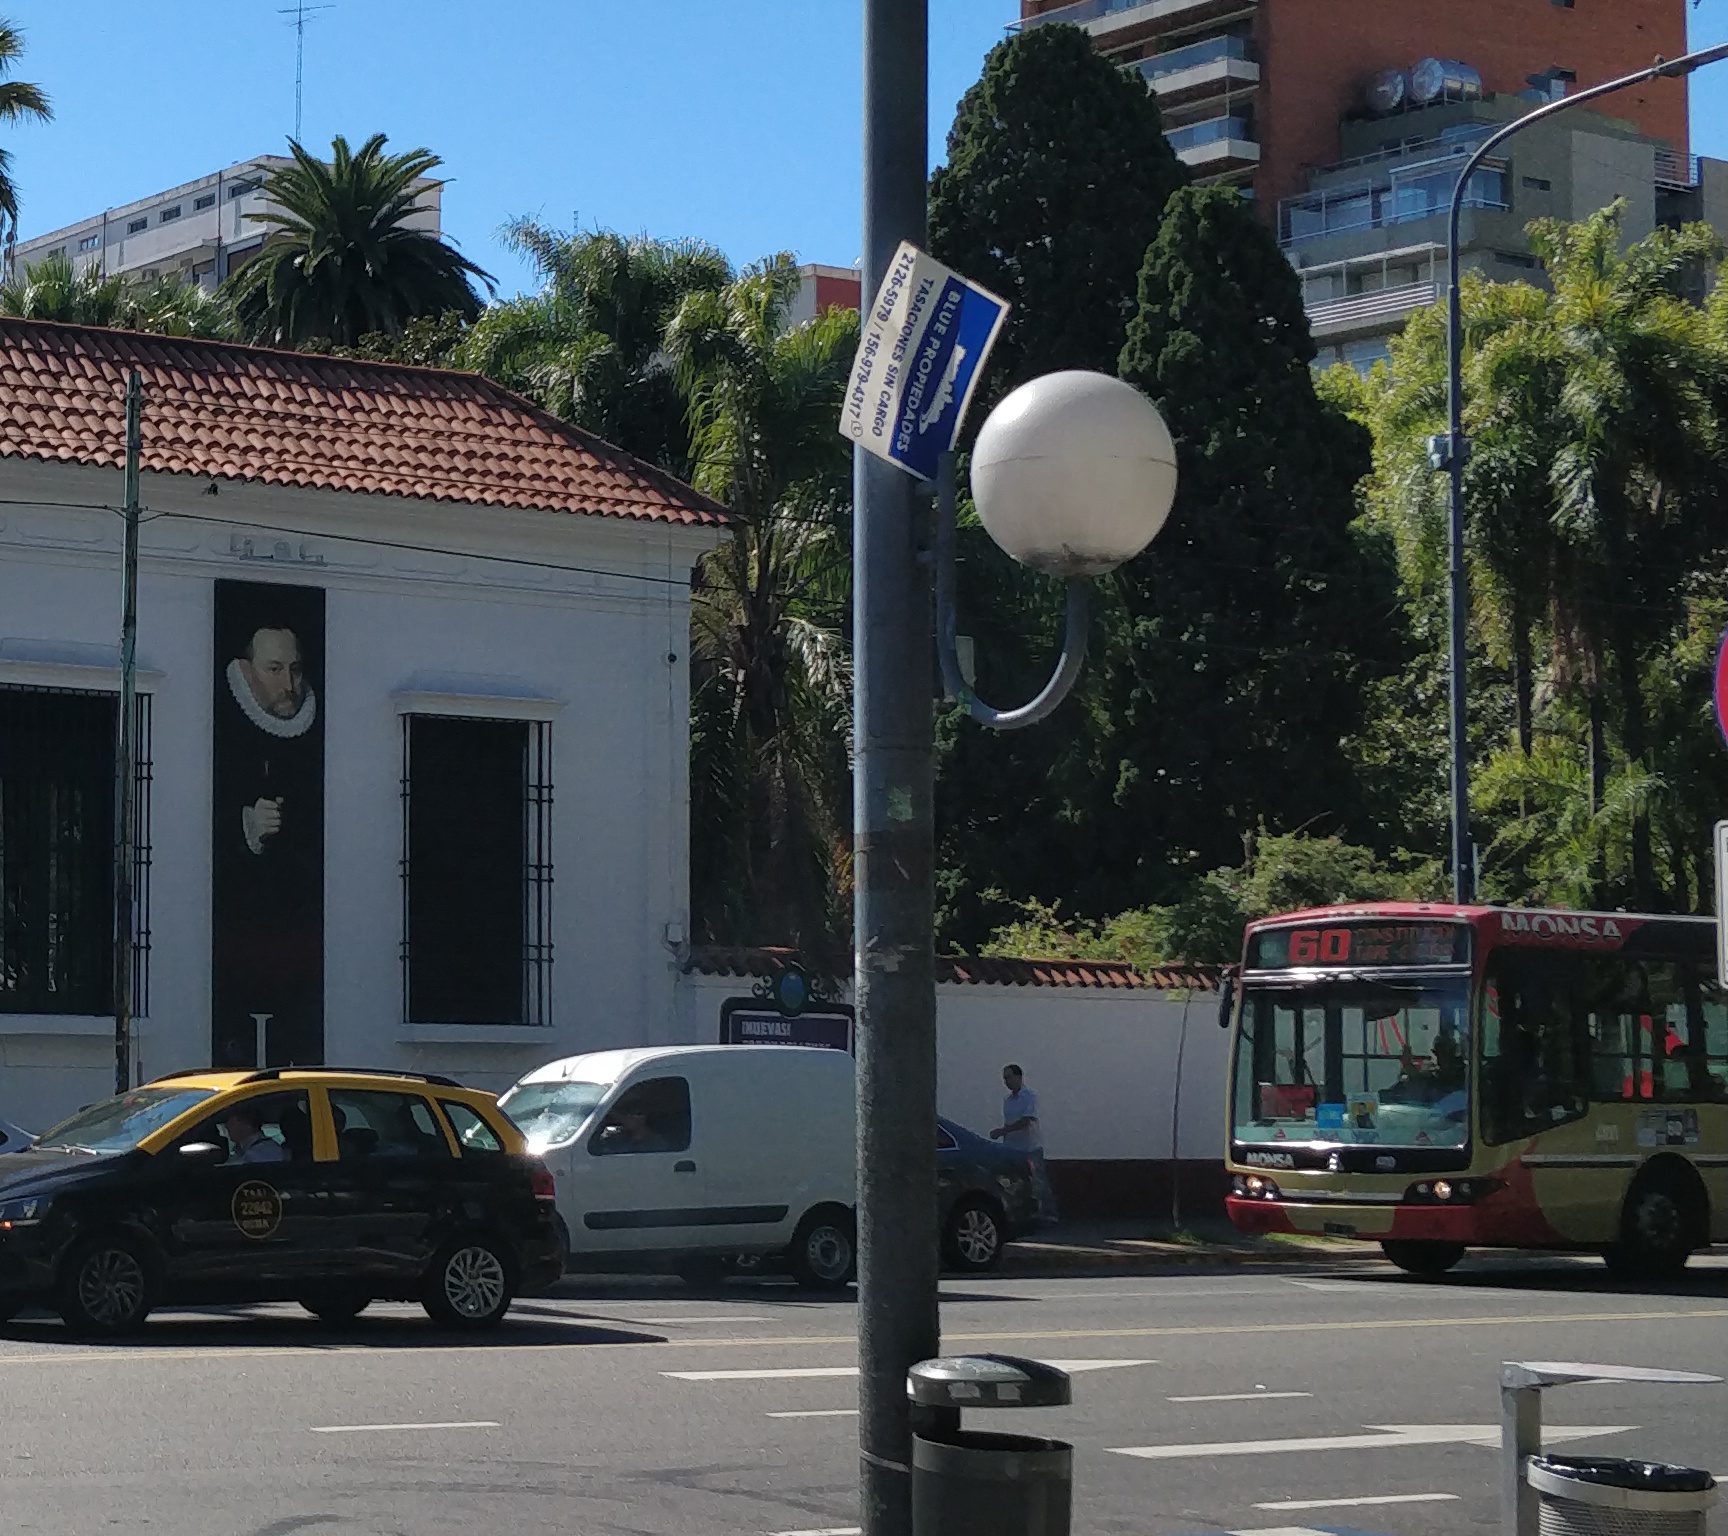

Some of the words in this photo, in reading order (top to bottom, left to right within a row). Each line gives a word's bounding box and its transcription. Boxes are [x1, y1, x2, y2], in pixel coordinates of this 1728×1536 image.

[876, 252, 915, 322] 2126-5979
[892, 277, 934, 362] TASACIONES
[933, 289, 962, 336] BLUE
[884, 364, 899, 390] SIN
[897, 336, 941, 452] PROPIEDADES
[872, 390, 891, 437] CARGO
[1288, 928, 1352, 962] 60
[1501, 913, 1623, 942] MONSA
